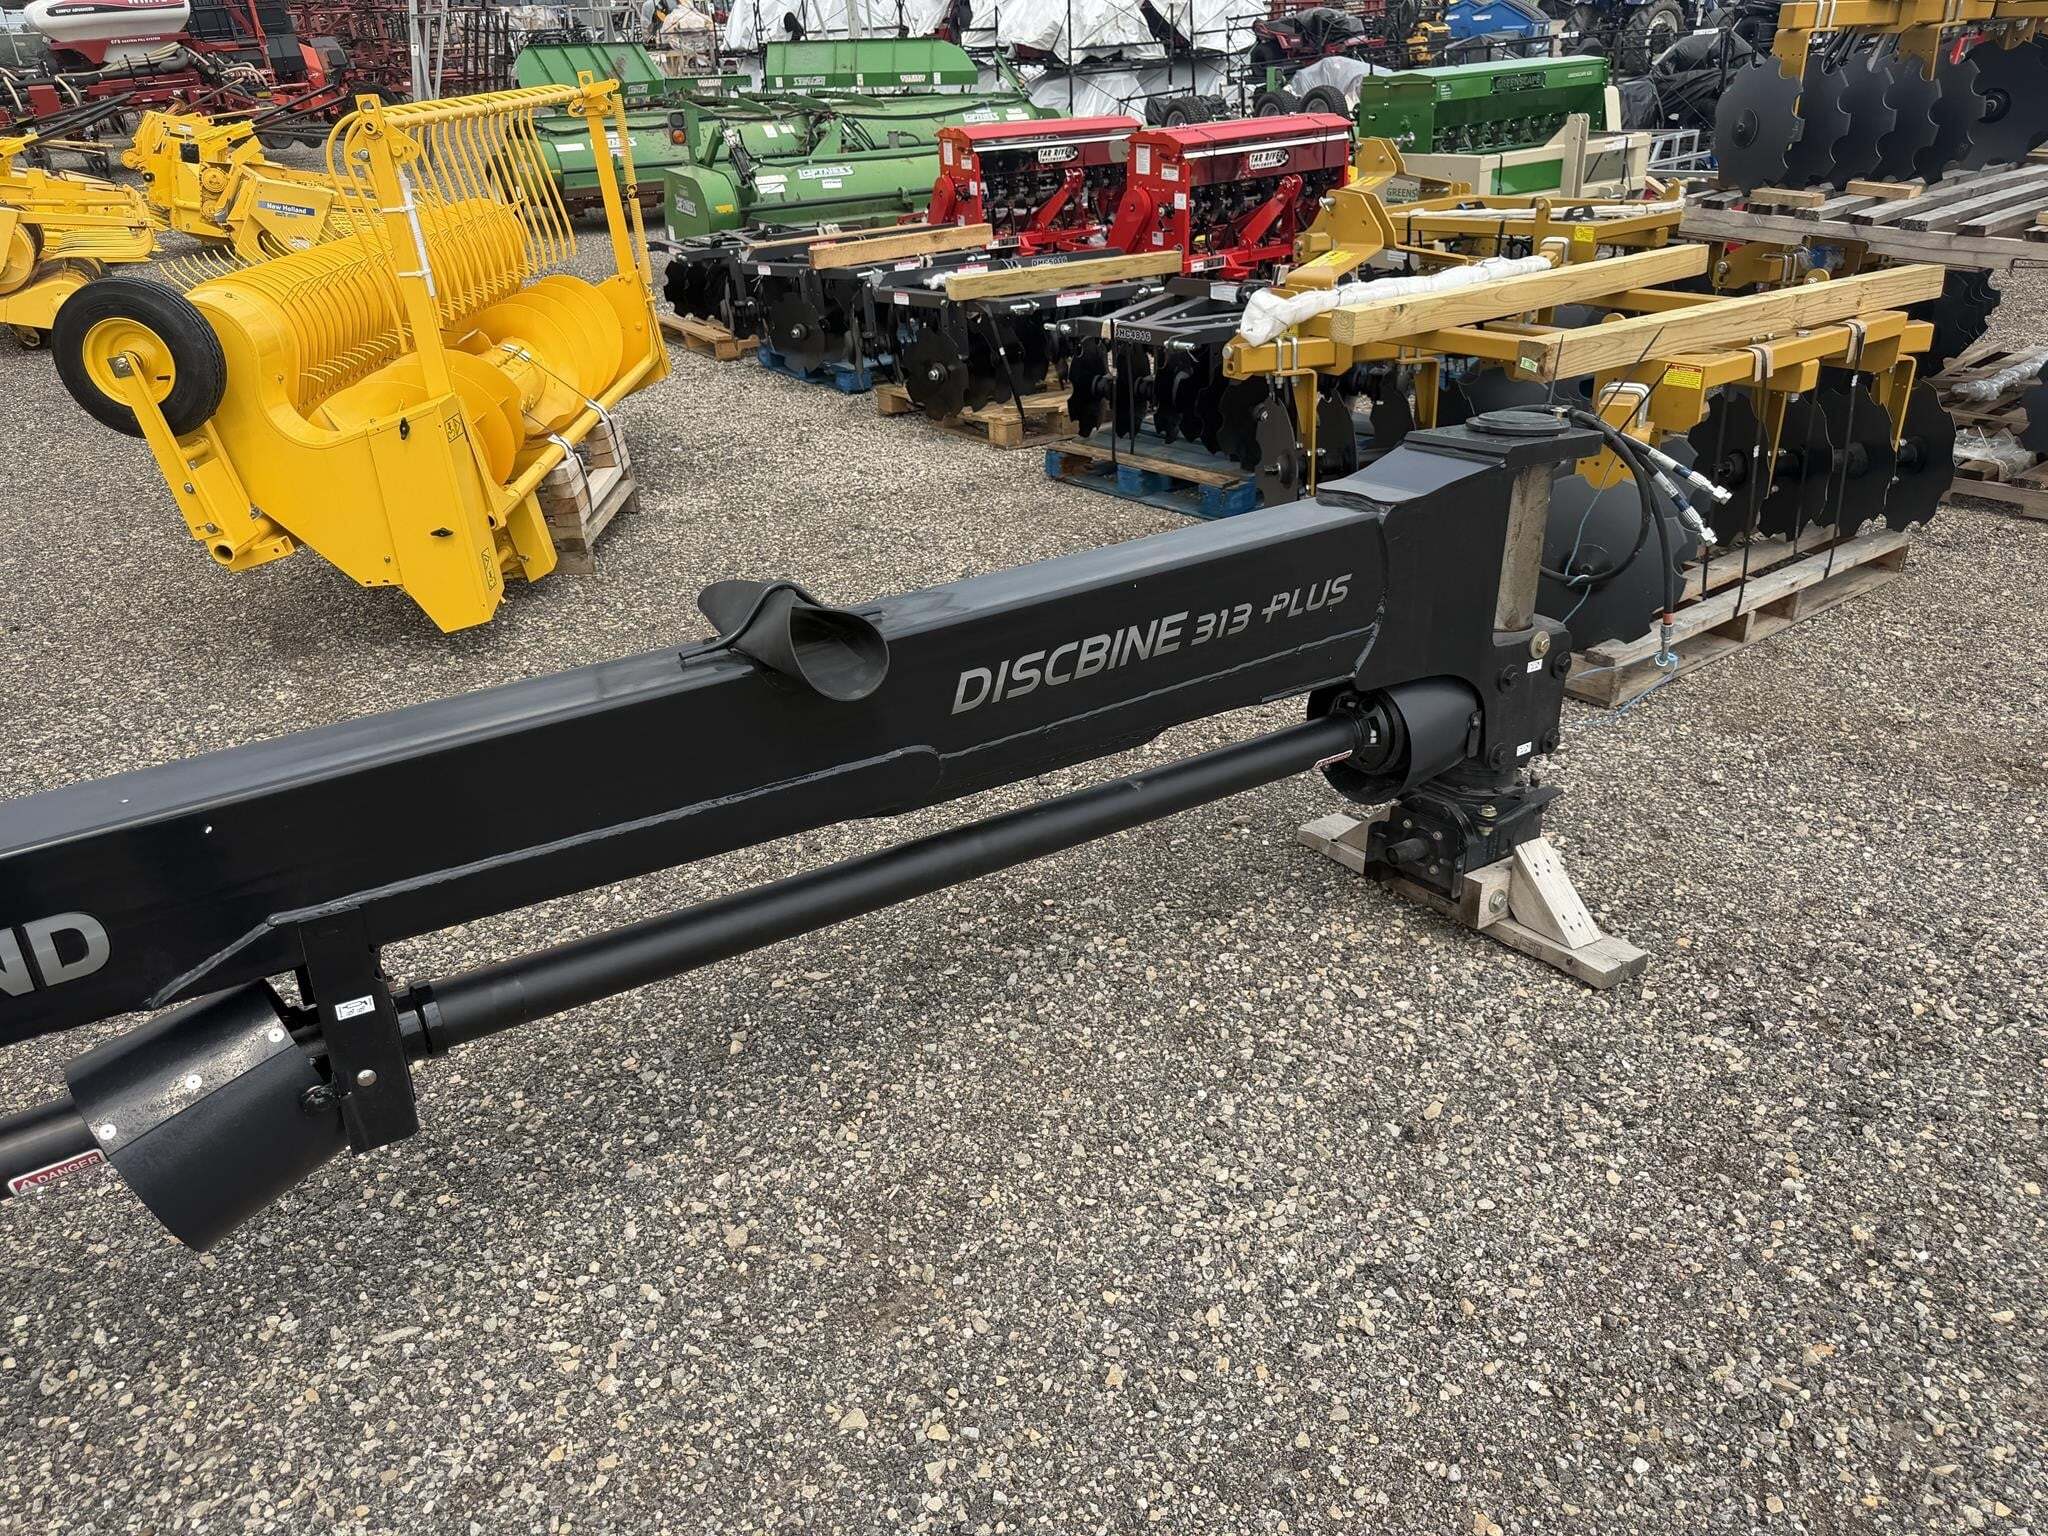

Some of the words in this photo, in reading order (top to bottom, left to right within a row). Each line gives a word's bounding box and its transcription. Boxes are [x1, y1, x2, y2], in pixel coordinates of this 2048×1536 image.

[1040, 148, 1053, 158] TAR
[1251, 153, 1264, 163] TAR
[266, 202, 281, 210] New
[282, 205, 307, 214] Holland
[952, 610, 1188, 715] DISCBINE
[1191, 602, 1253, 646] 313
[1261, 573, 1353, 623] PLUS
[36, 1155, 99, 1184] DANGER
